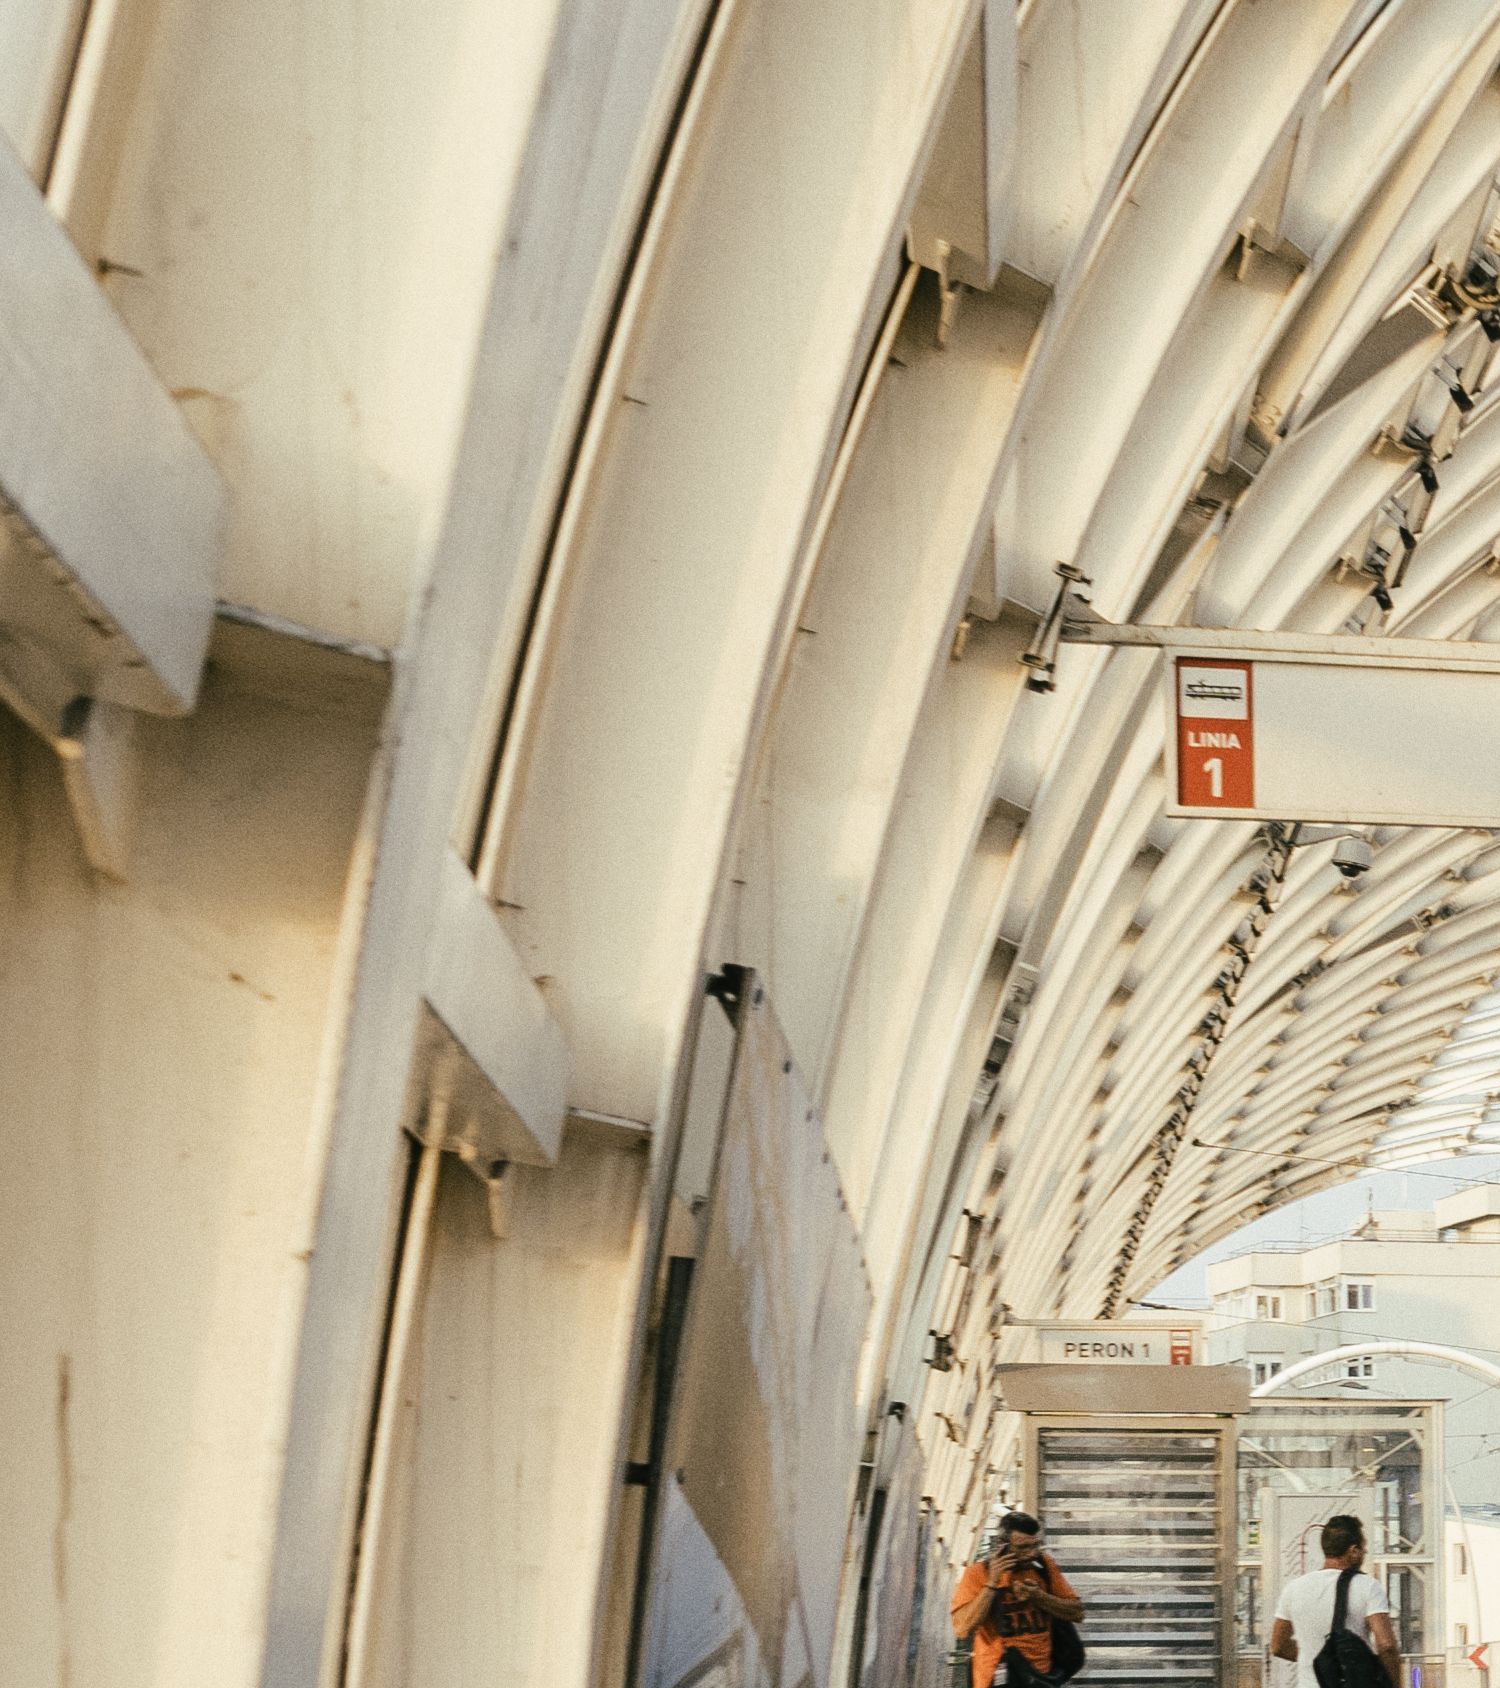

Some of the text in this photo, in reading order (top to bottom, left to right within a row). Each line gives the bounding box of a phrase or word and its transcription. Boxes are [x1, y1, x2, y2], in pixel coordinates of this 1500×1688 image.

[1188, 731, 1242, 750] LINIA
[1202, 757, 1223, 798] 1
[1064, 1342, 1150, 1358] PERON 1
